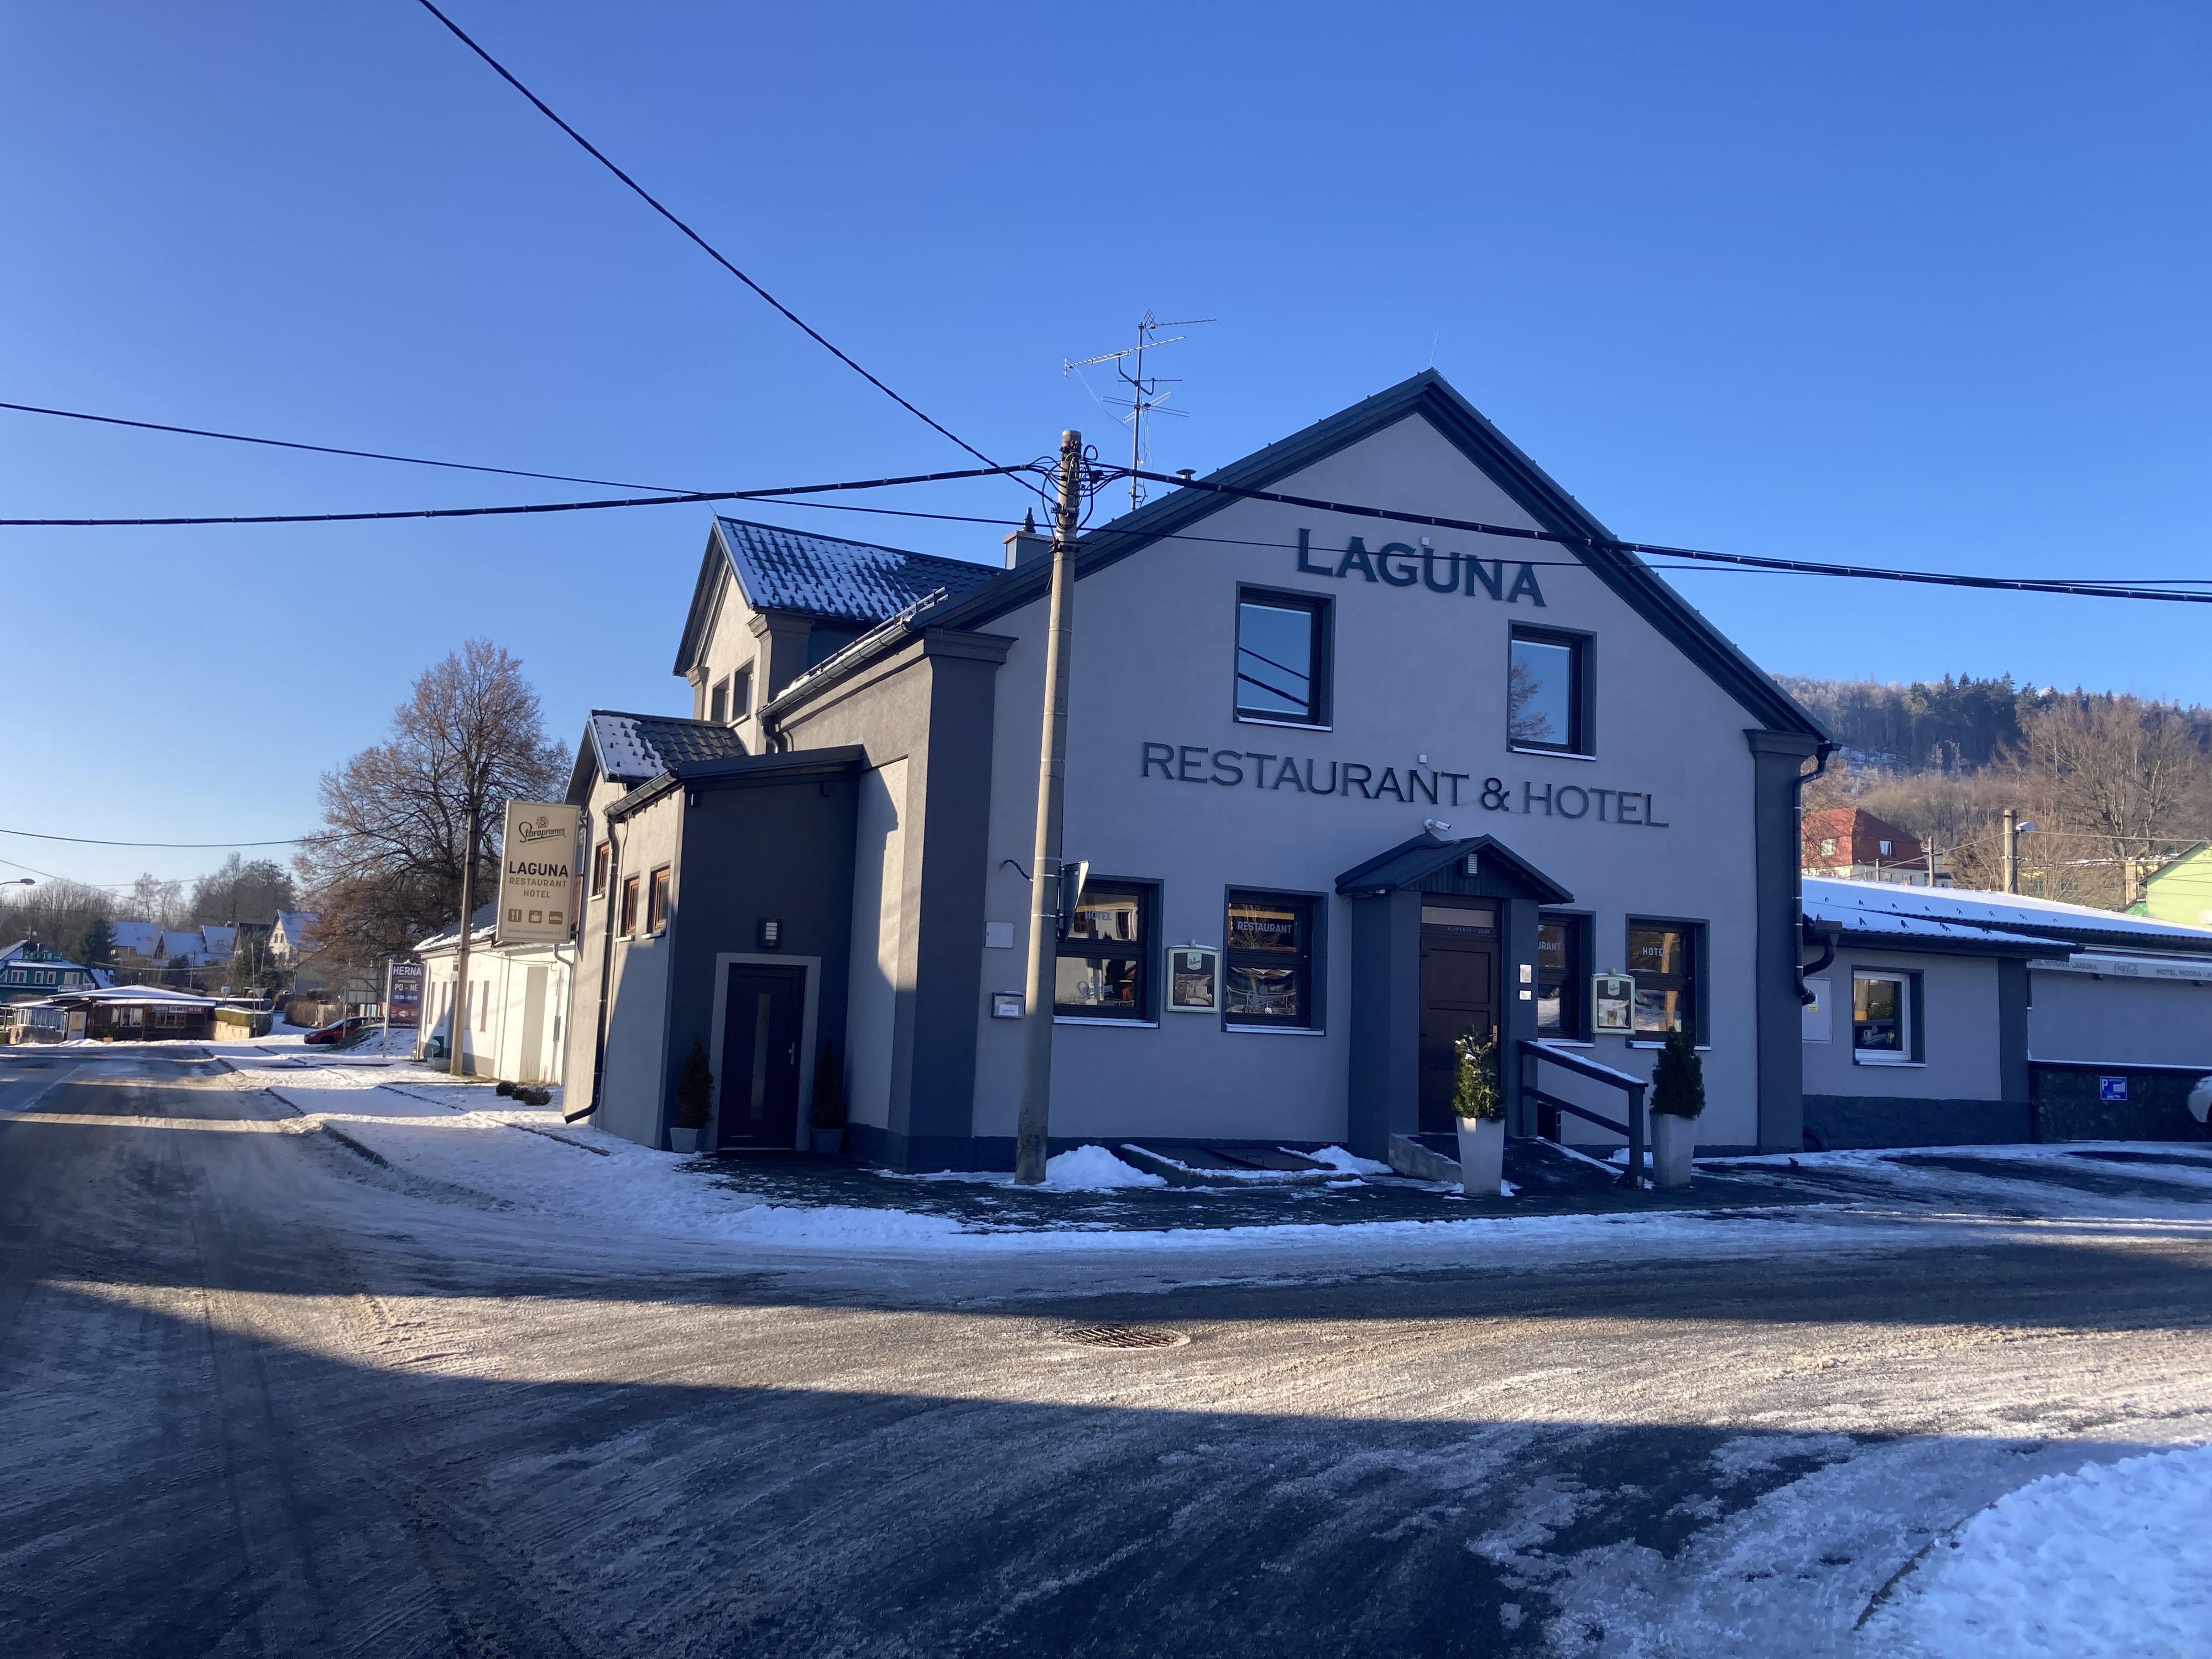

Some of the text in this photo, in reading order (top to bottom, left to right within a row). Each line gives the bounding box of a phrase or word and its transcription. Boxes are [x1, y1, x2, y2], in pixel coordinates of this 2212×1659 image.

[1297, 528, 1547, 607] LAGUNA
[1142, 742, 1669, 828] RESTAURANT & HOTEL
[519, 821, 566, 843] Staropramen
[509, 861, 568, 877] LAGUNA
[509, 877, 567, 888] RESTAURANT
[523, 889, 550, 898] HOTEL
[1085, 911, 1113, 921] HOTEL
[1238, 921, 1292, 933] RESTAURANT
[1642, 947, 1664, 956] HOTE
[393, 966, 422, 975] HERNA
[2102, 1079, 2108, 1090] P
